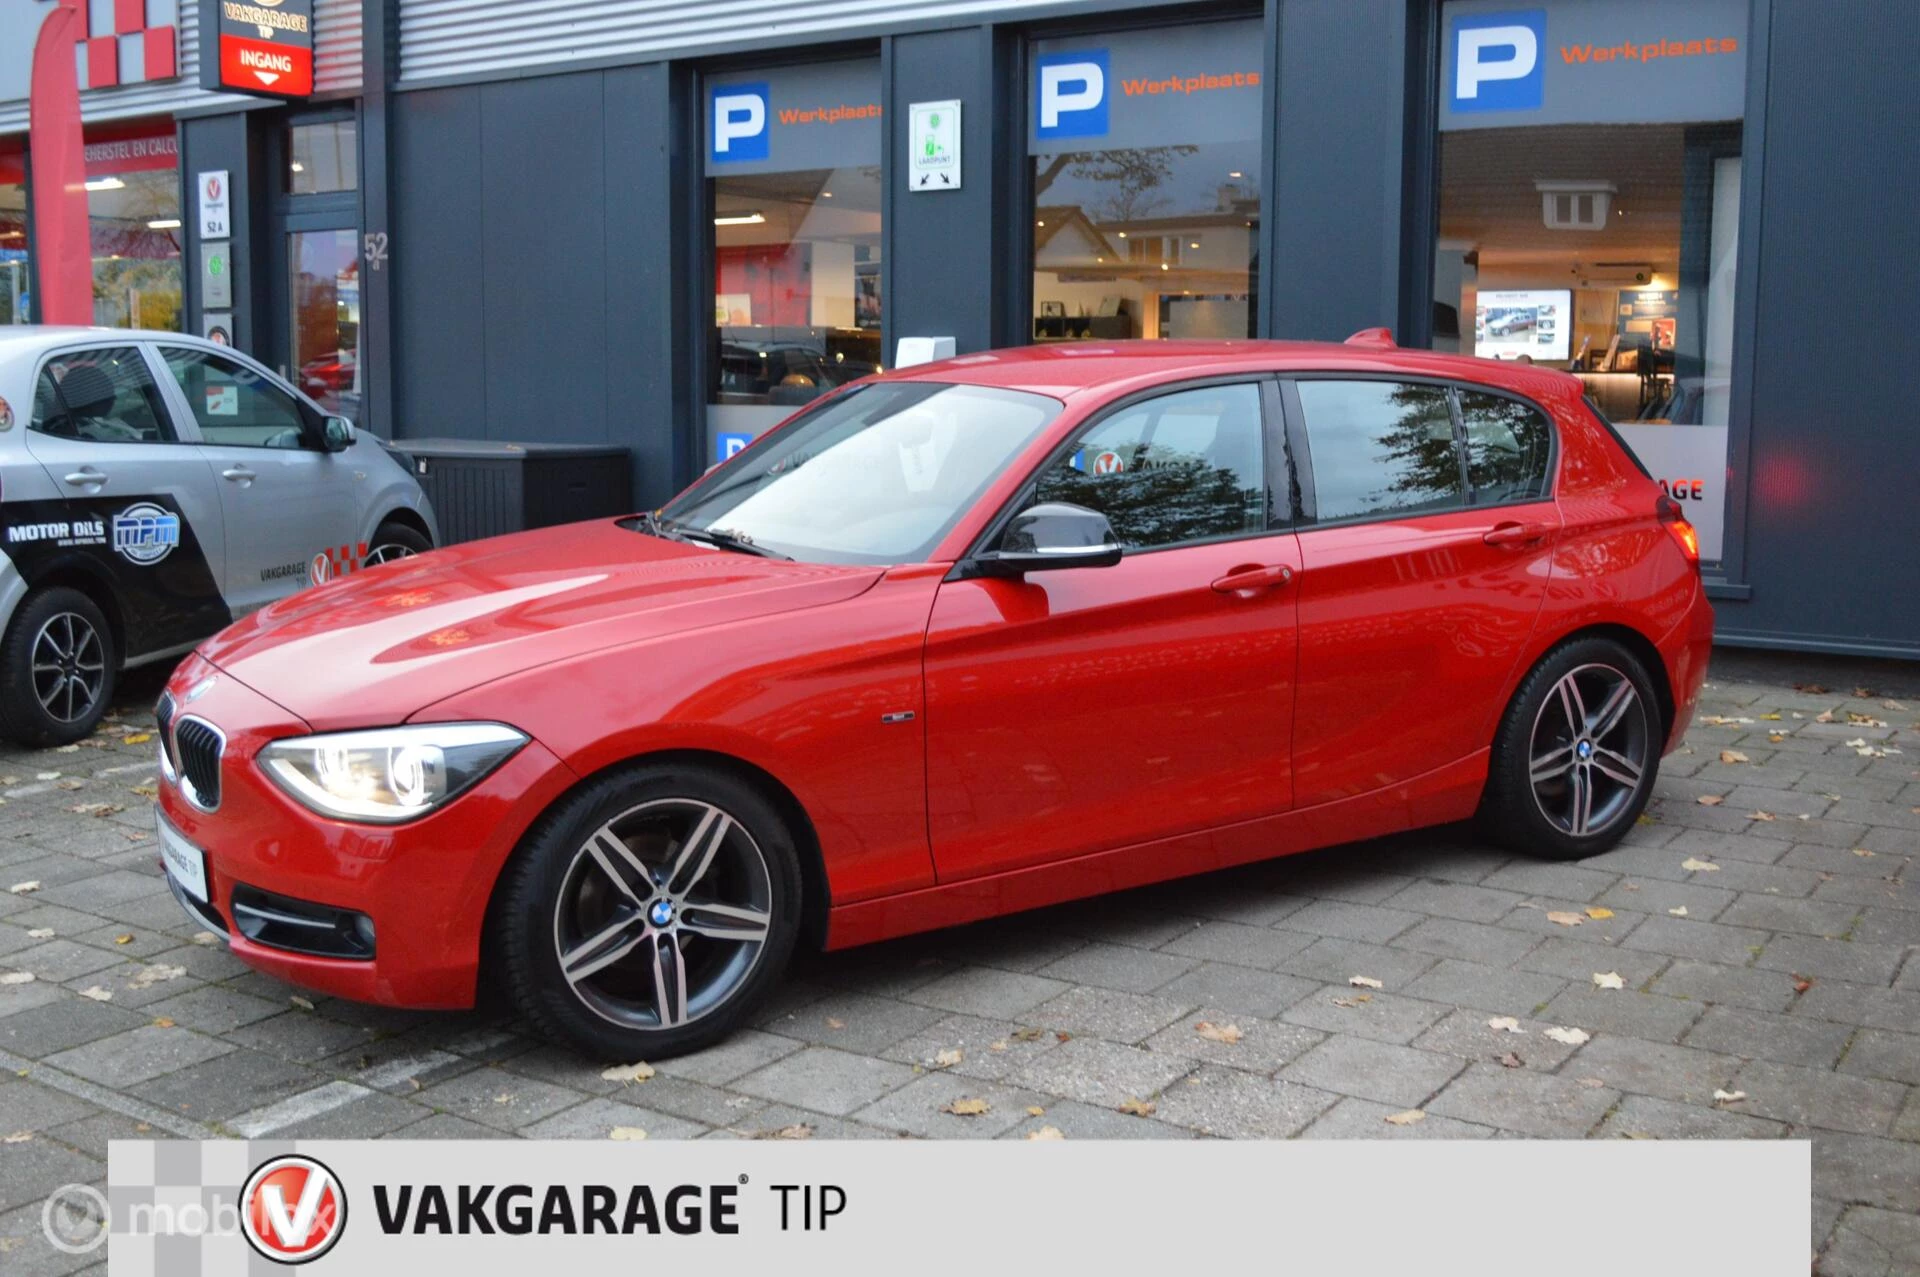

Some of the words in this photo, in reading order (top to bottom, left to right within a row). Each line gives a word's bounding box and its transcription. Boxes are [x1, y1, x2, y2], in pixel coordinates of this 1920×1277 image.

[223, 2, 308, 32] VAKGARAGE
[240, 49, 292, 72] INGANG
[1456, 25, 1538, 99] P
[1560, 37, 1738, 64] Werkplaats
[1041, 62, 1104, 128] P
[1121, 71, 1261, 96] Werkplaats
[715, 94, 765, 152] P
[132, 139, 147, 157] EN
[207, 221, 217, 232] 52
[217, 221, 224, 232] A
[365, 232, 388, 260] 52
[9, 523, 69, 543] MOTOR
[260, 561, 306, 582] VAKGARAGE
